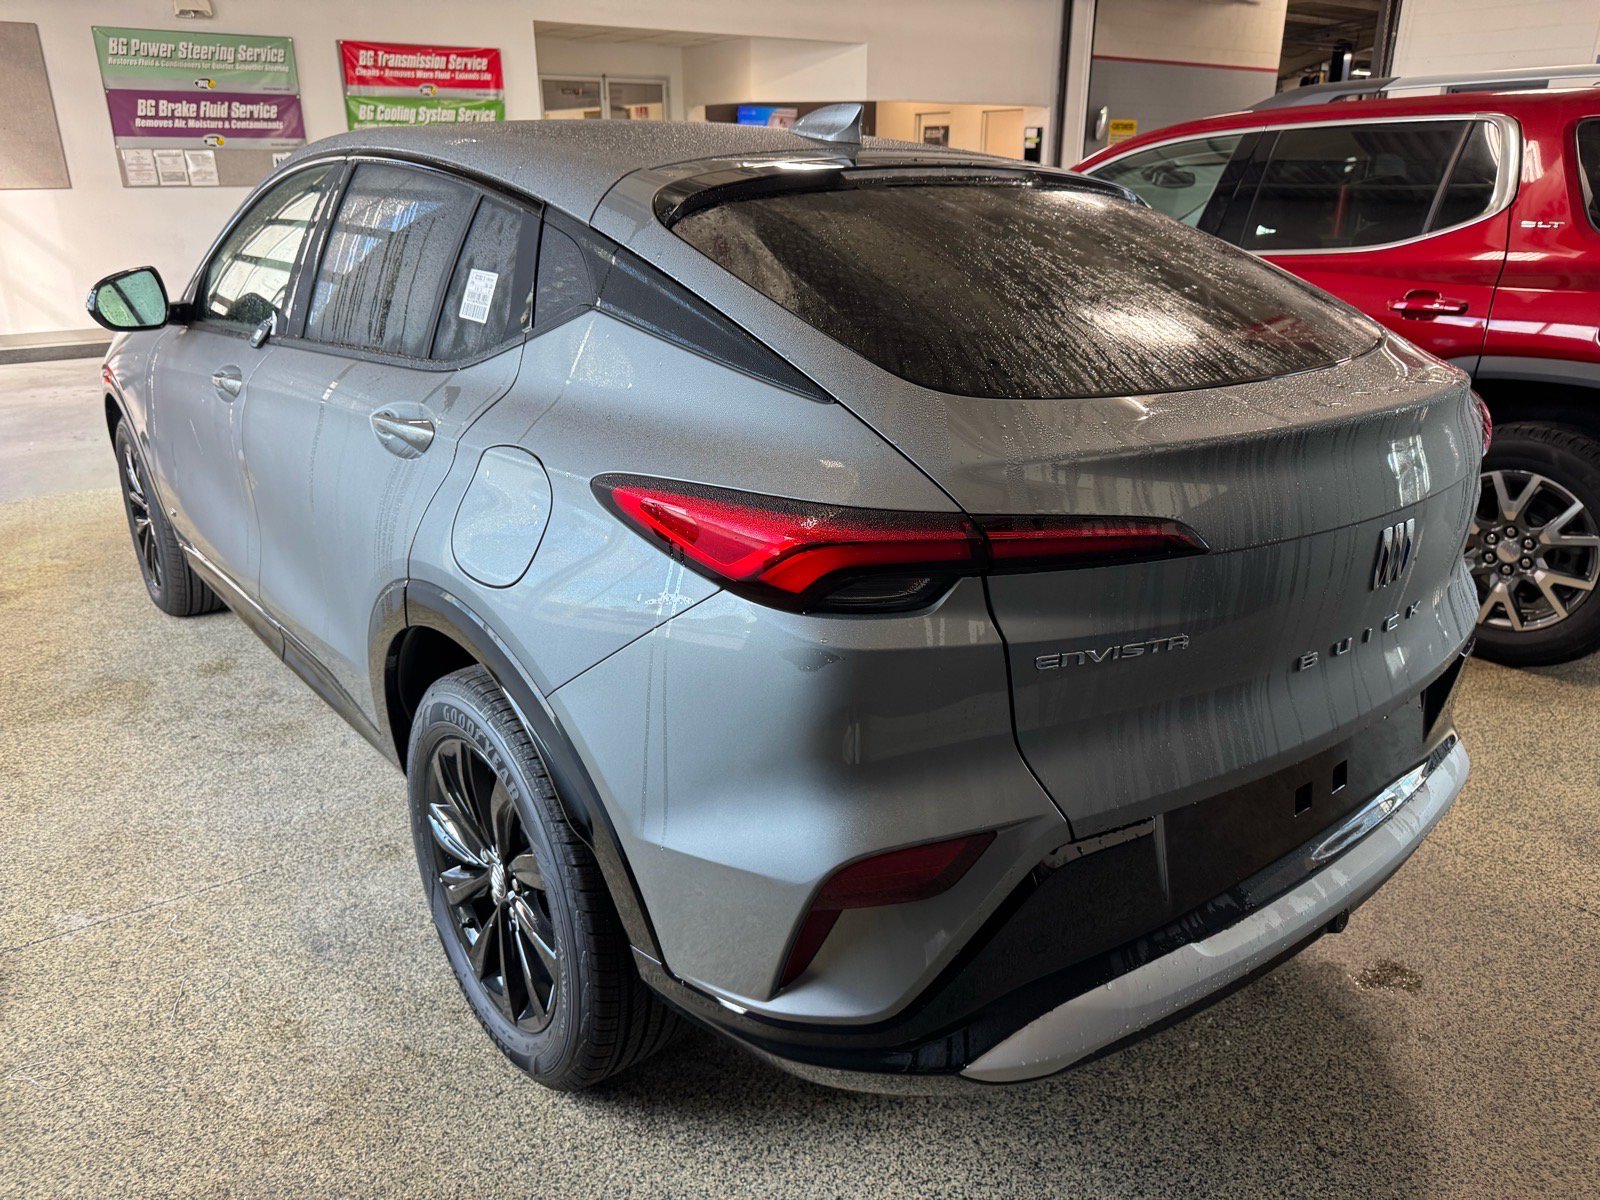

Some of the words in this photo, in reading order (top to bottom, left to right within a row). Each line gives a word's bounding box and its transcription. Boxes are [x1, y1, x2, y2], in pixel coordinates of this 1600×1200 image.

[108, 37, 128, 55] BG
[131, 38, 175, 58] Power
[178, 42, 234, 63] Steering
[238, 45, 285, 62] Service
[359, 49, 375, 66] BG
[377, 51, 446, 69] Transmission
[449, 54, 488, 70] Service
[108, 57, 137, 66] Restores
[355, 67, 380, 77] Cleans
[435, 71, 450, 79] Fluid
[137, 99, 156, 117] BG
[158, 99, 197, 118] Brake
[200, 101, 229, 118] Fluid
[231, 102, 278, 119] Service
[359, 104, 375, 121] BG
[376, 105, 416, 123] Cooling
[418, 107, 456, 125] System
[458, 108, 496, 122] Service
[135, 117, 173, 128] Removes
[187, 119, 223, 129] Moisture
[224, 120, 230, 128] &
[231, 119, 284, 129] Contaminants
[1521, 220, 1565, 228] SLT
[1299, 600, 1422, 671] BUICK
[1035, 633, 1191, 671] ENVISTA
[443, 705, 519, 800] GOODYEAR
